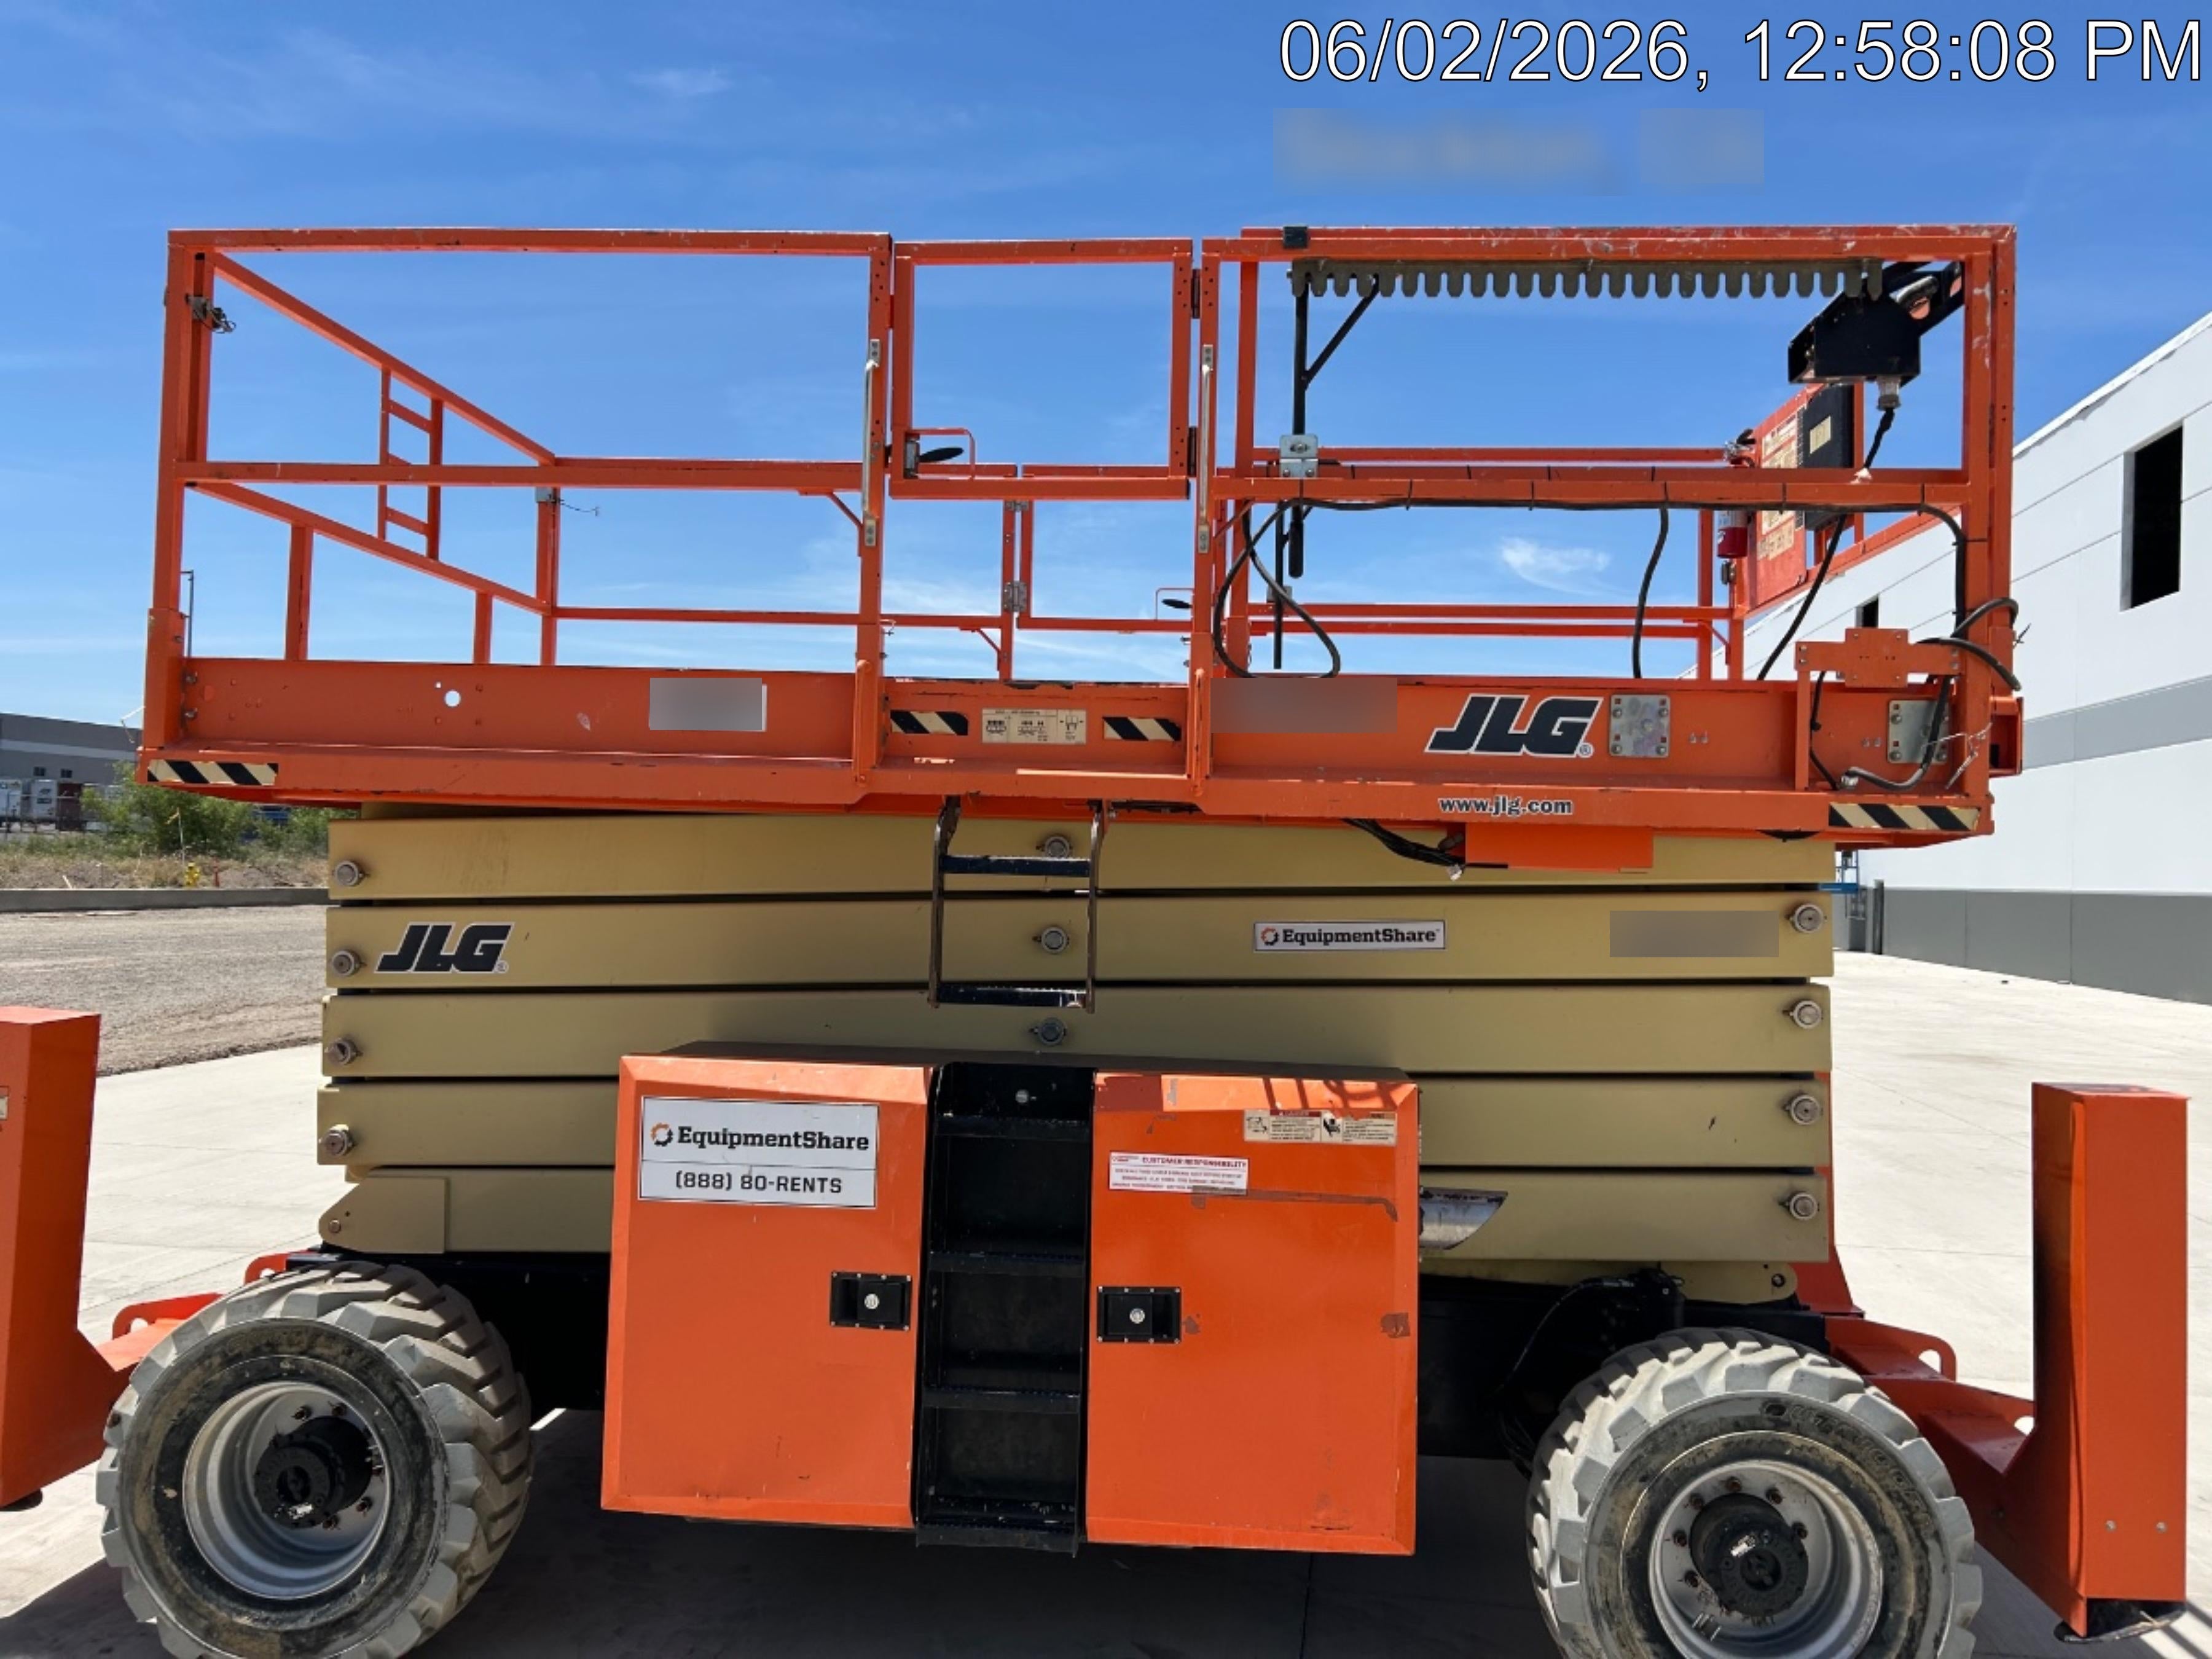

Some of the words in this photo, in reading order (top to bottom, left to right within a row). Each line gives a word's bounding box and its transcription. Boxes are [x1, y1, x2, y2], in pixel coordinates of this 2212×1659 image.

[1424, 694, 1604, 758] JLG
[1438, 795, 1573, 817] www.jlg.com
[374, 922, 516, 974] JLG
[1282, 928, 1436, 946] EquipmentShare
[677, 1126, 869, 1150] EquipmentShare
[676, 1171, 732, 1190] (888)
[740, 1175, 842, 1193] 80-RENTS
